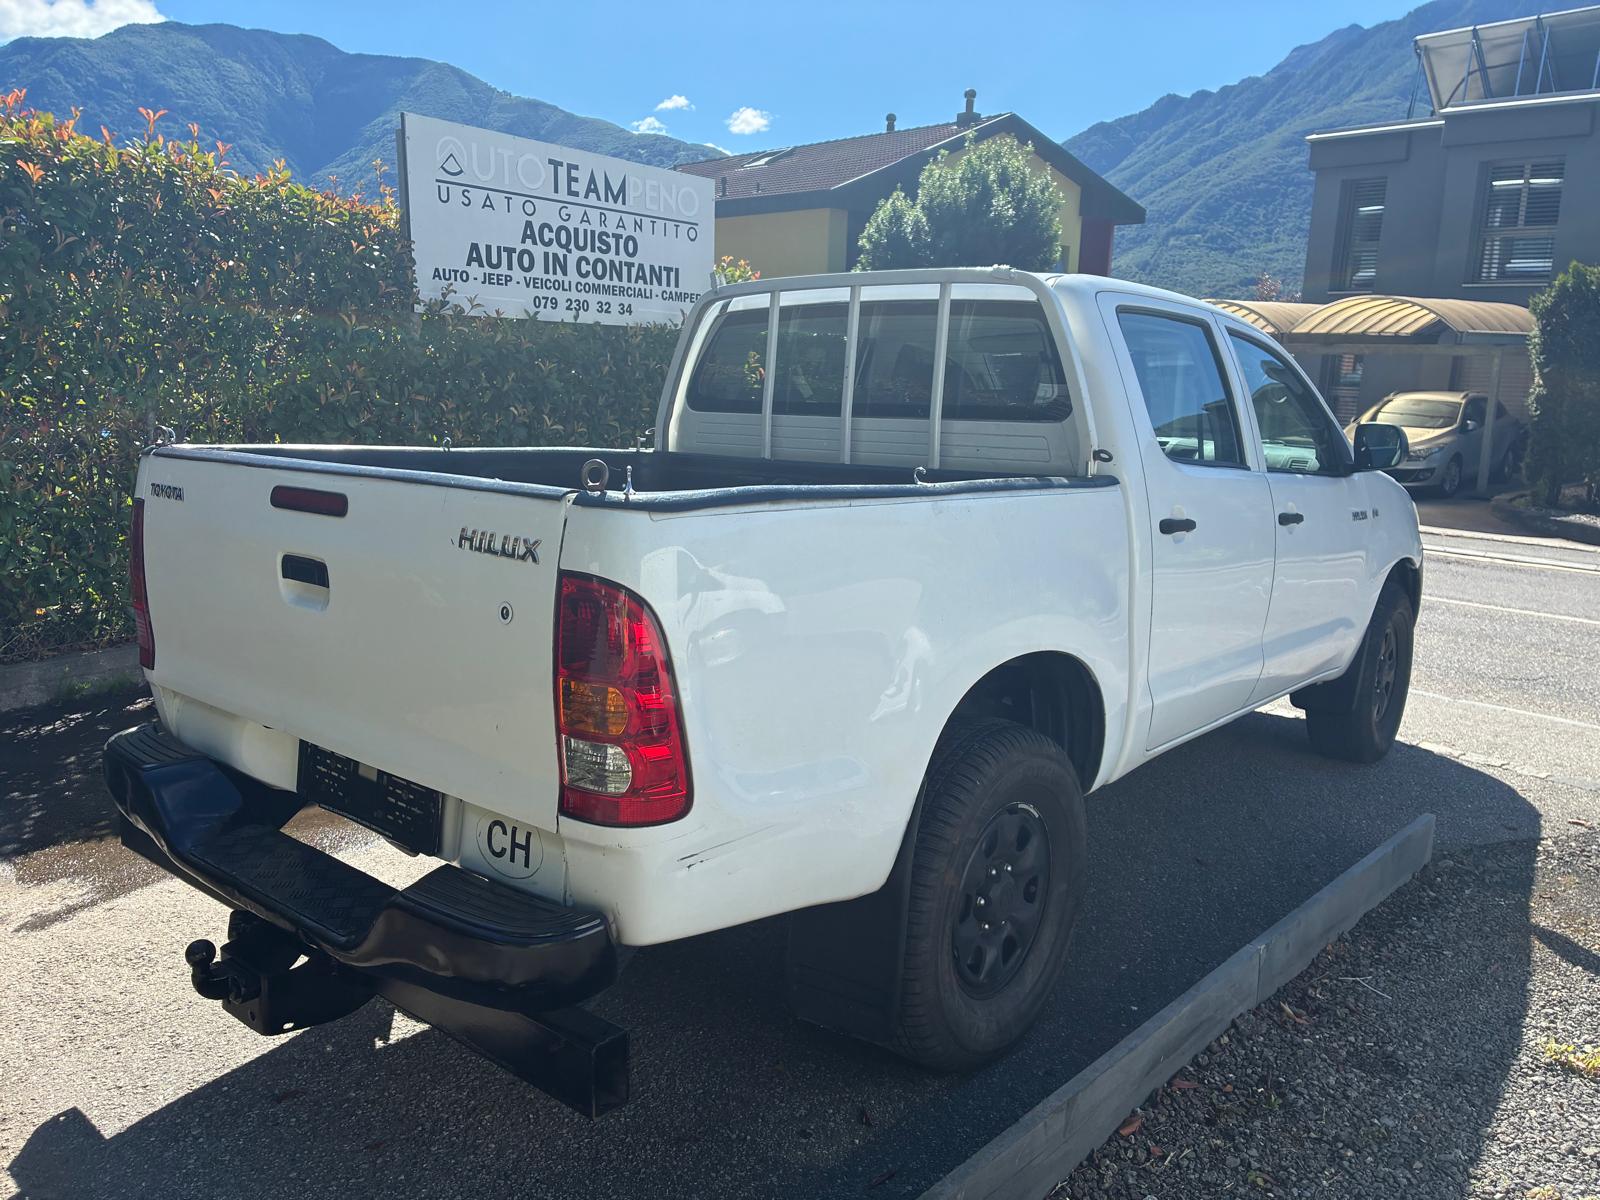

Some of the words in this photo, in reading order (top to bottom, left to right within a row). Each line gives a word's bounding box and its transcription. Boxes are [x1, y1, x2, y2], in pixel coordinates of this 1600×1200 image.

[437, 184, 537, 217] USATO
[558, 205, 699, 242] GARANTITO
[520, 220, 639, 258] ACQUISTO
[432, 267, 470, 283] AUTO
[481, 272, 513, 287] JEEP
[523, 276, 572, 292] VEICOLI
[575, 281, 653, 299] COMMERCIALI
[465, 242, 536, 273] AUTO
[543, 251, 568, 277] IN
[575, 255, 680, 289] CONTANTI
[533, 295, 558, 310] 079
[565, 298, 589, 312] 230
[596, 300, 612, 315] 32
[618, 302, 633, 316] 34
[150, 482, 185, 502] TOYOTA
[458, 526, 543, 566] HILUX
[487, 819, 532, 869] CH
